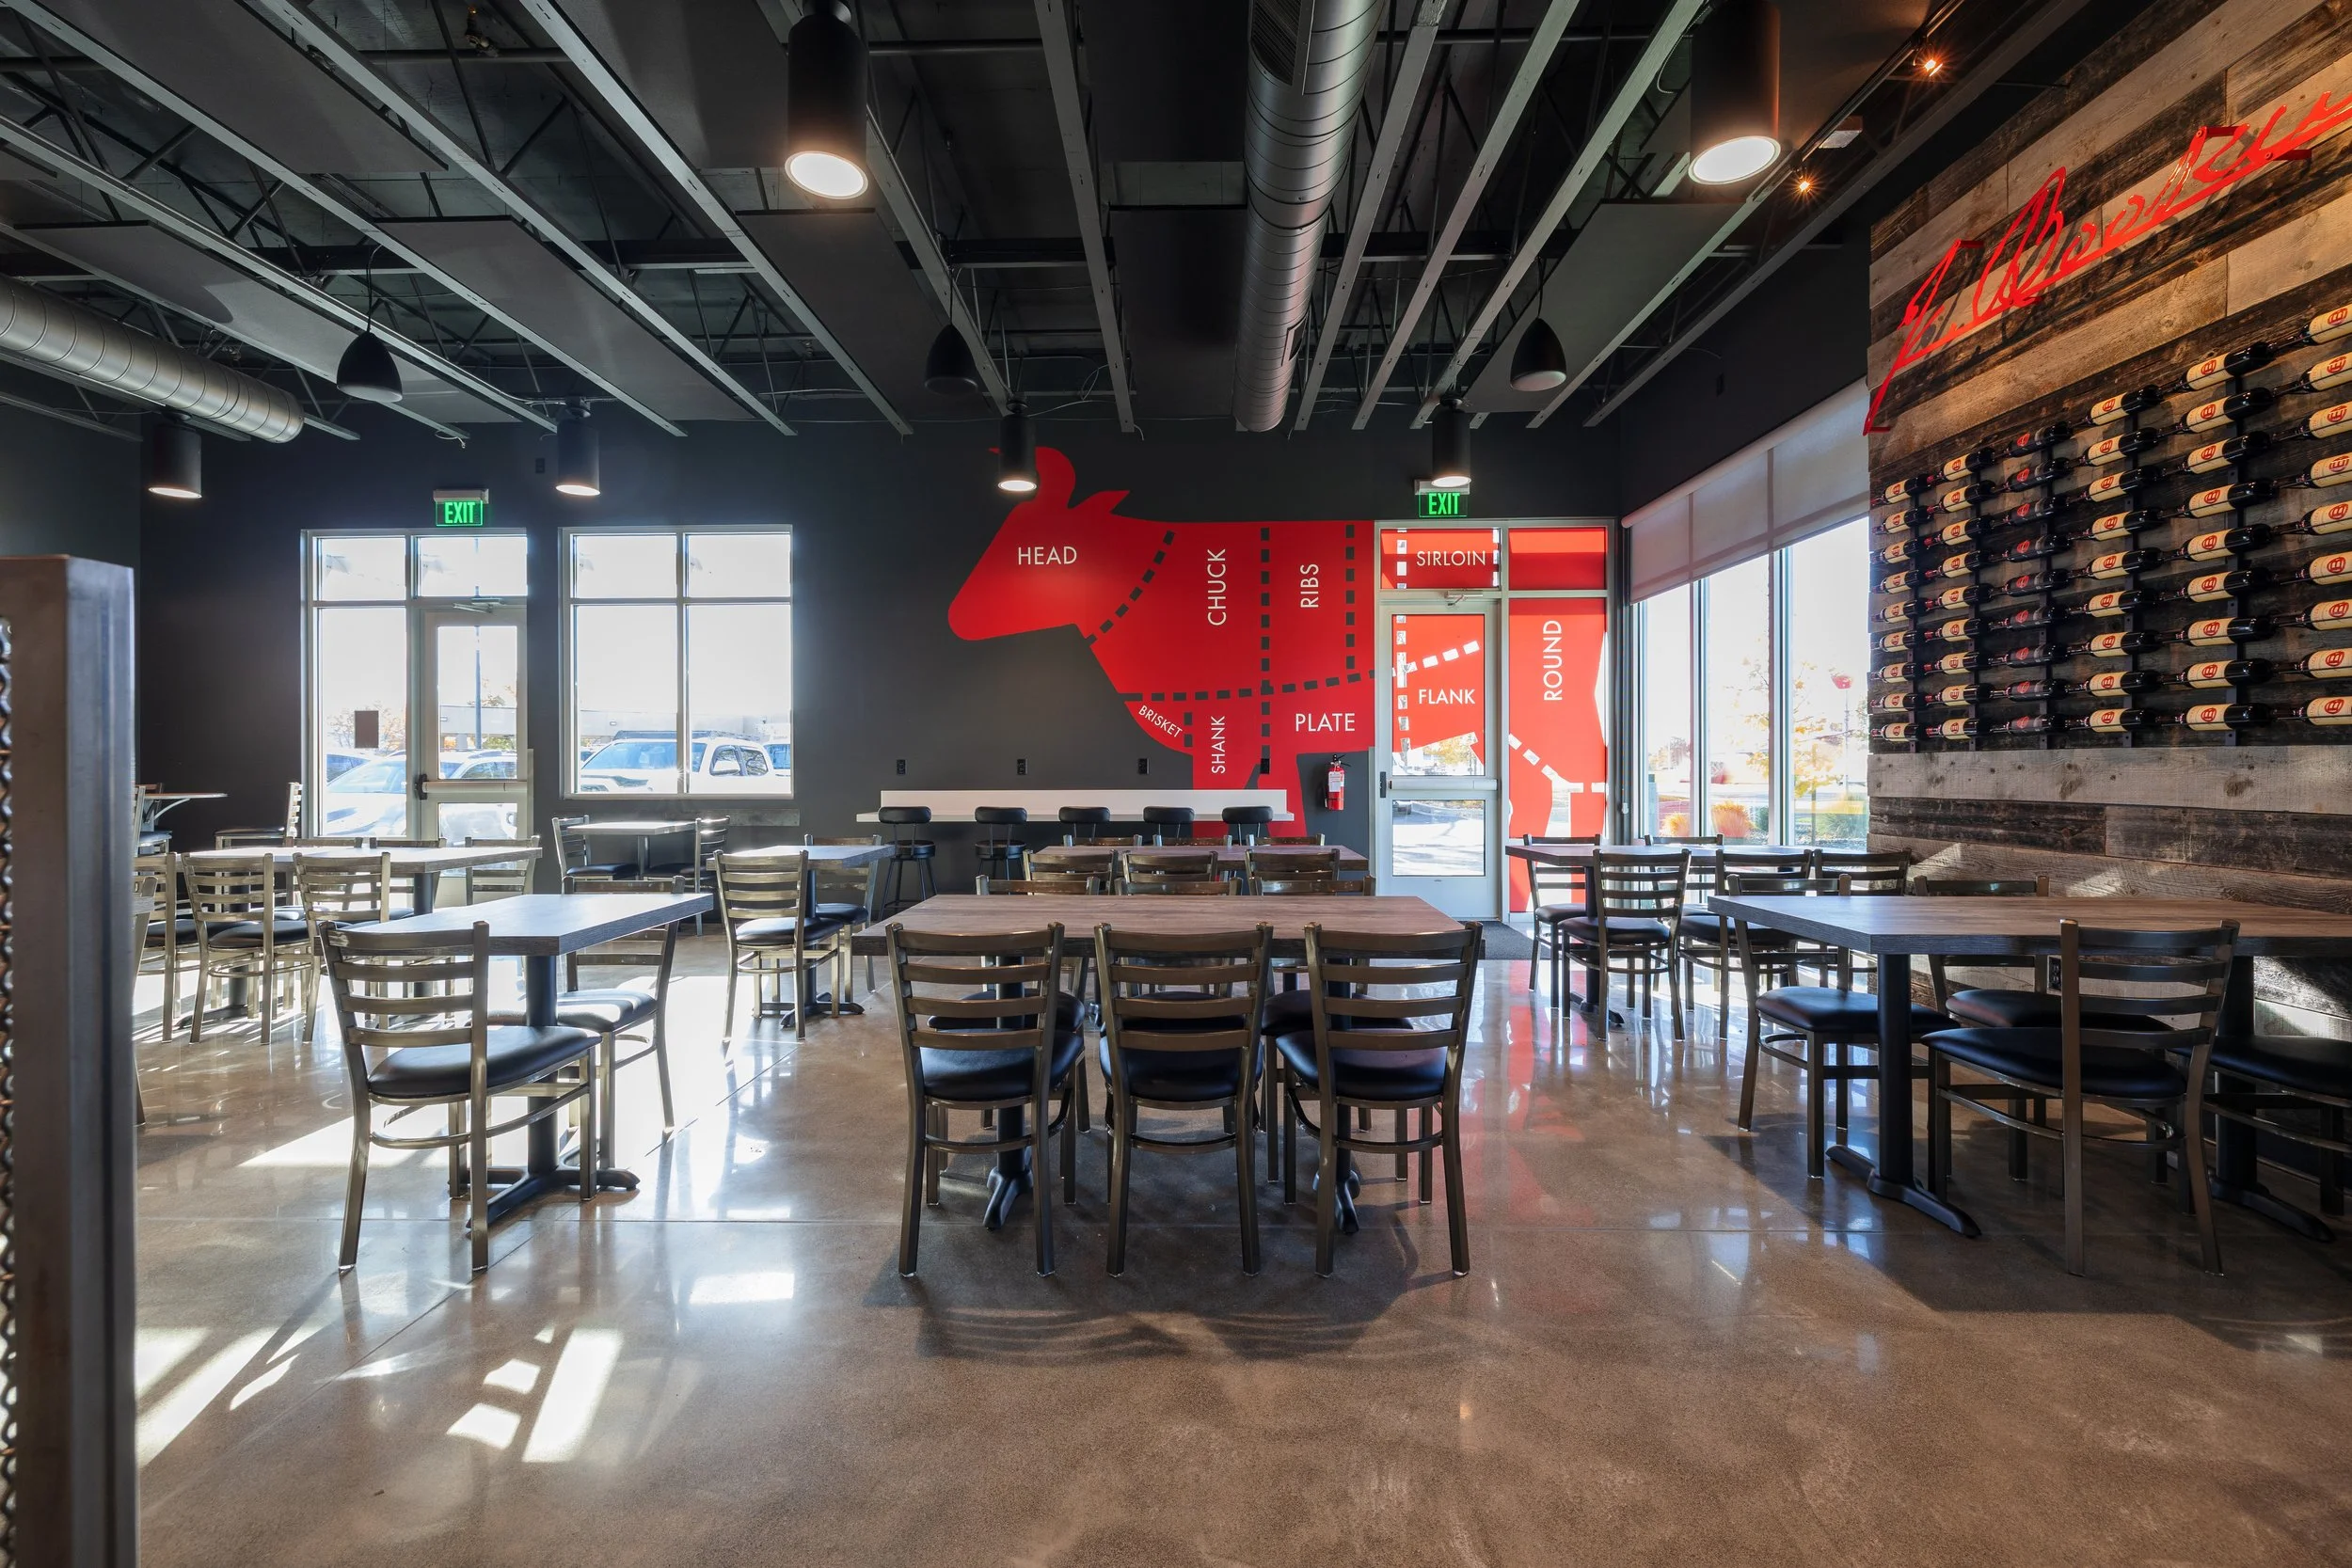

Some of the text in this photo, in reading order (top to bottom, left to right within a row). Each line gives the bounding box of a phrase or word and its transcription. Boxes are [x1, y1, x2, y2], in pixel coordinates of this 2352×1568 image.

[444, 501, 476, 524] EXIT
[1428, 491, 1461, 515] EXIT
[1017, 546, 1077, 565] HEAD
[1415, 549, 1486, 567] SIRLOIN
[1206, 548, 1227, 626] CHUCK
[1299, 562, 1319, 609] RIBS
[1542, 619, 1564, 701] ROUND
[1418, 689, 1476, 705] FLANK
[1137, 705, 1184, 739] BRISKET
[1295, 712, 1356, 732] PLATE
[1210, 715, 1226, 775] SHANK
